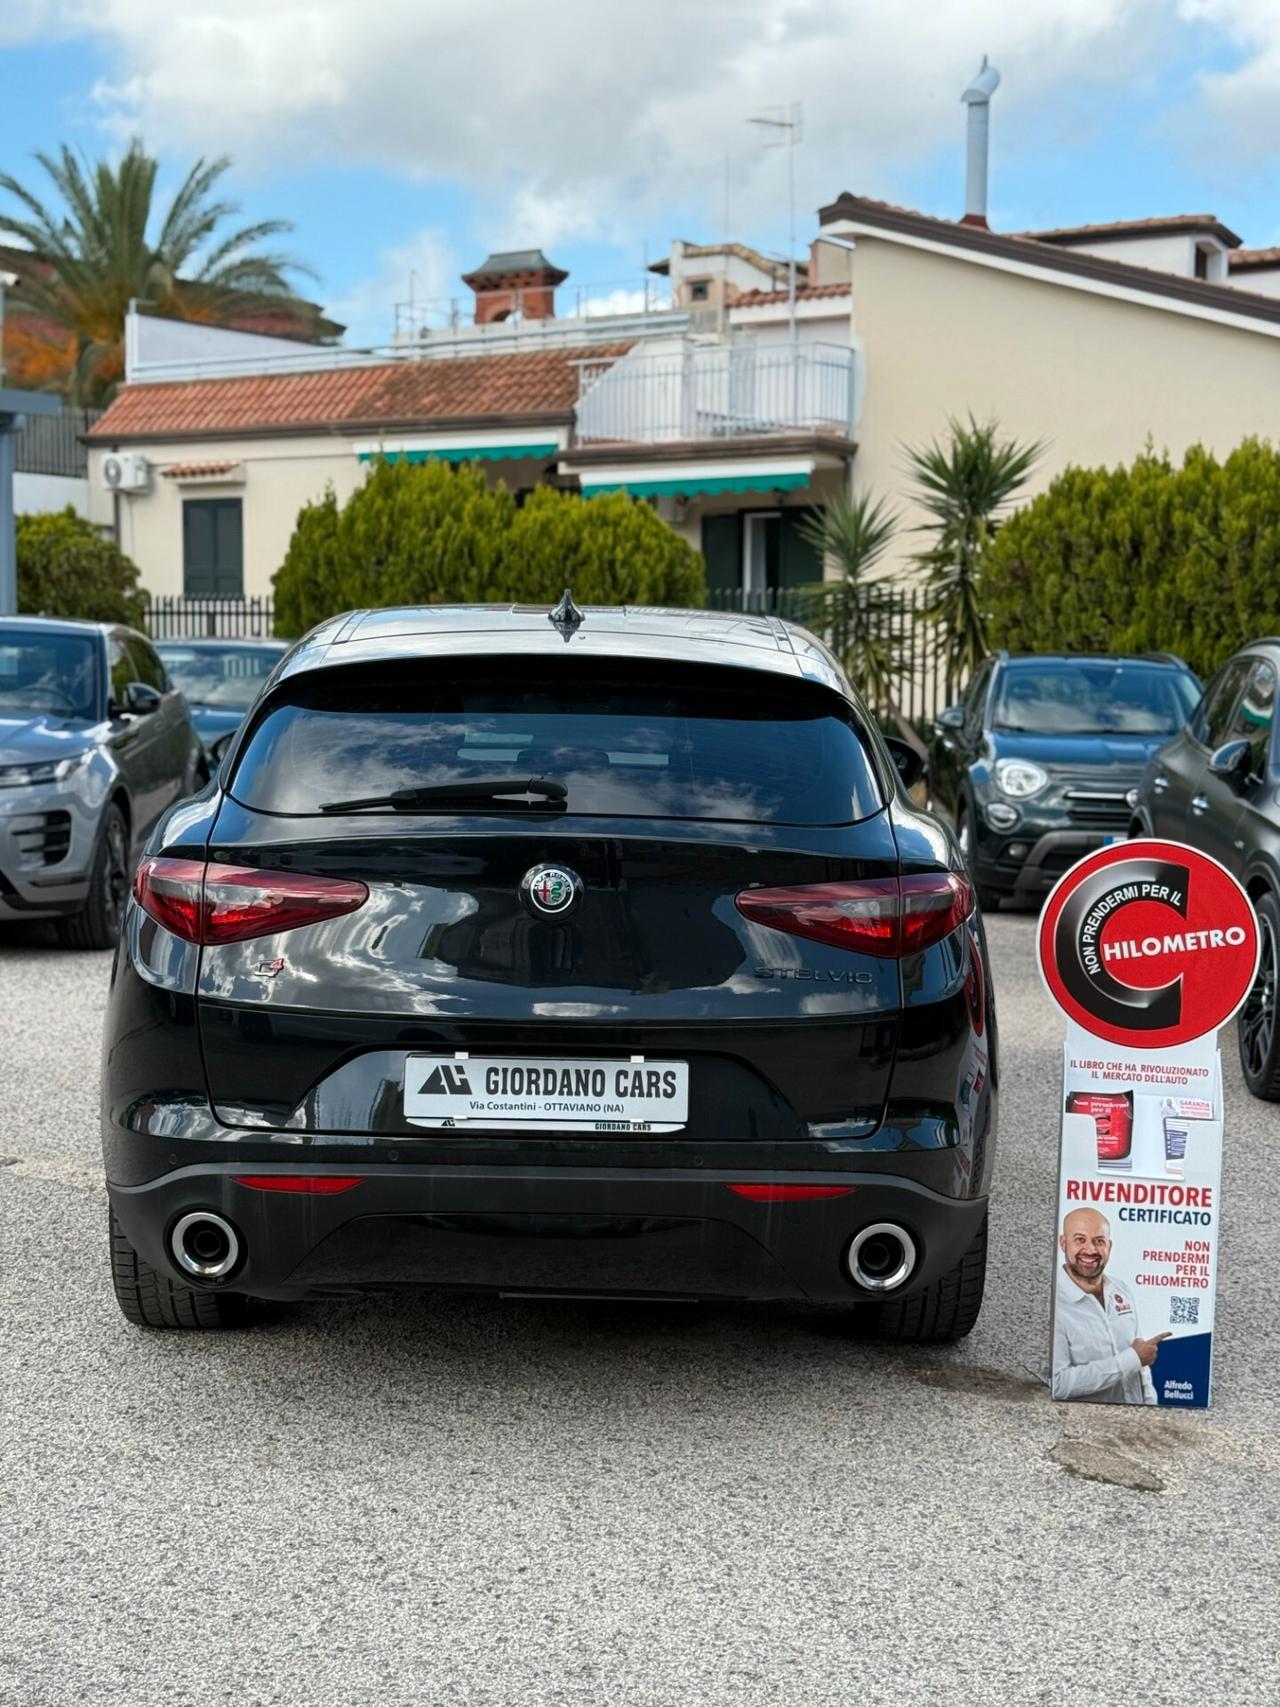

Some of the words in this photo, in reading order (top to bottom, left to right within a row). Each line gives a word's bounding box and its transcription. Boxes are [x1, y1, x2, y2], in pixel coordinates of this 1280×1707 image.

[1142, 884, 1170, 898] PER
[1170, 890, 1182, 906] IL
[1082, 886, 1139, 942] PRENDERMI
[1083, 946, 1101, 975] NON
[754, 966, 873, 984] STELVIO
[1070, 1060, 1078, 1068] IL
[1080, 1060, 1104, 1070] LIBRO
[1106, 1062, 1123, 1071] CHE
[1125, 1063, 1137, 1072] HA
[1140, 1064, 1209, 1077] RIVOLUZIONATO
[486, 1066, 606, 1098] GIORDANO
[615, 1070, 677, 1099] CARS
[1092, 1070, 1098, 1079] IL
[1102, 1072, 1143, 1082] MERCATO
[1144, 1074, 1188, 1085] DELL'AUTO
[470, 1101, 485, 1110] Via
[486, 1102, 536, 1112] Costantini
[544, 1102, 602, 1112] OTTAVIANO
[603, 1102, 624, 1114] (NA)
[1066, 1180, 1212, 1208] RIVENDITORE
[1118, 1207, 1212, 1226] CERTIFICATO
[1184, 1240, 1210, 1252] NON
[1142, 1250, 1210, 1264] PRENDERMI
[1176, 1264, 1196, 1276] PER
[1200, 1266, 1210, 1276] IL
[1135, 1274, 1209, 1289] CHILOMETRO
[1164, 1380, 1192, 1390] Alfredo
[1164, 1390, 1194, 1400] Bellucci
